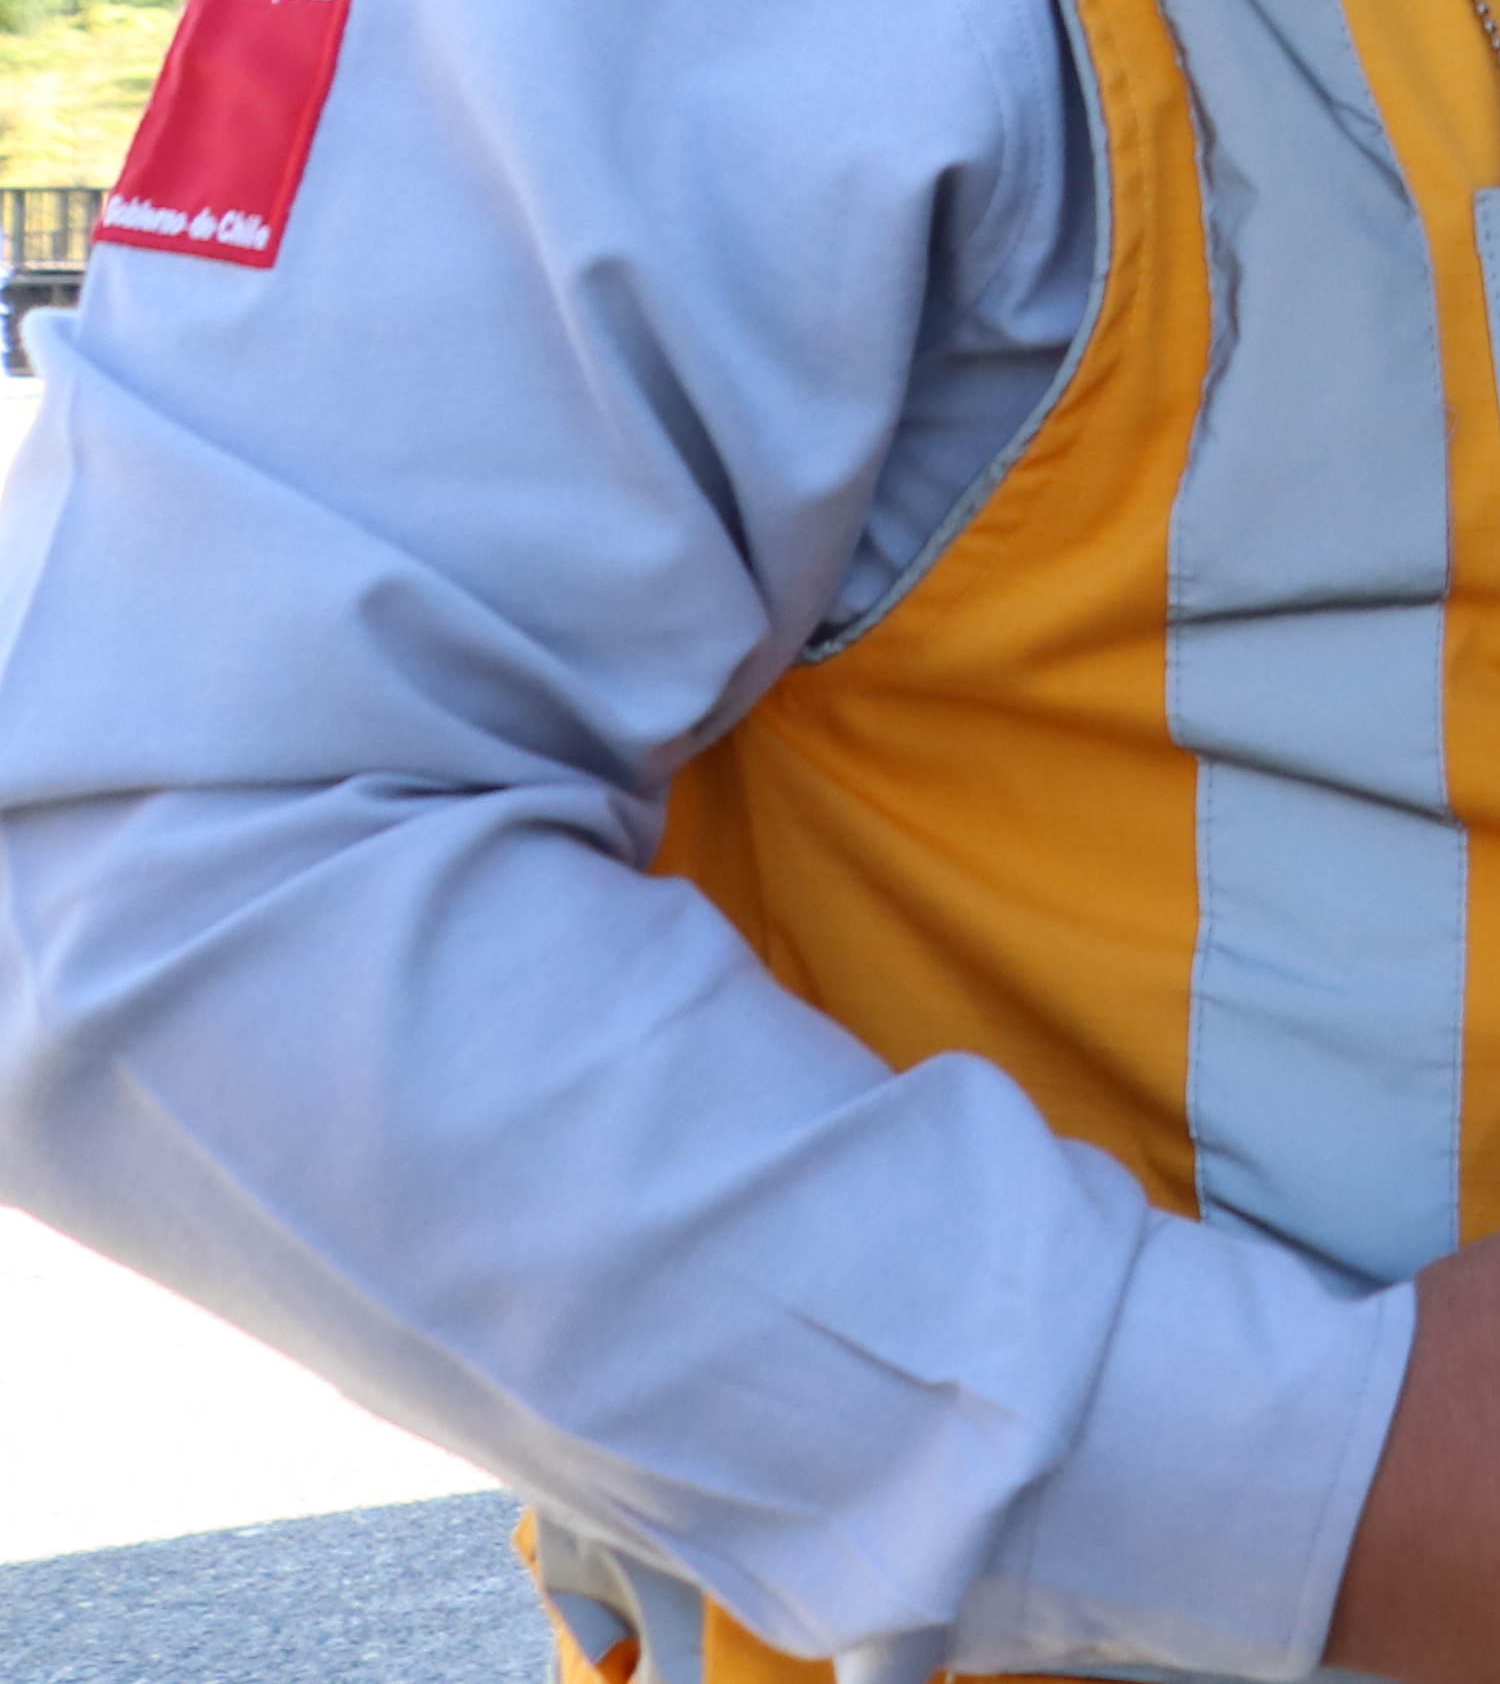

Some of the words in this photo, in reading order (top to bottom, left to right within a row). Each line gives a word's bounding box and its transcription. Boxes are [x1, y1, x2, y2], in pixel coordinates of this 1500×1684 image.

[103, 193, 187, 235] Gobierno
[188, 211, 217, 242] de
[216, 209, 272, 251] Chile
